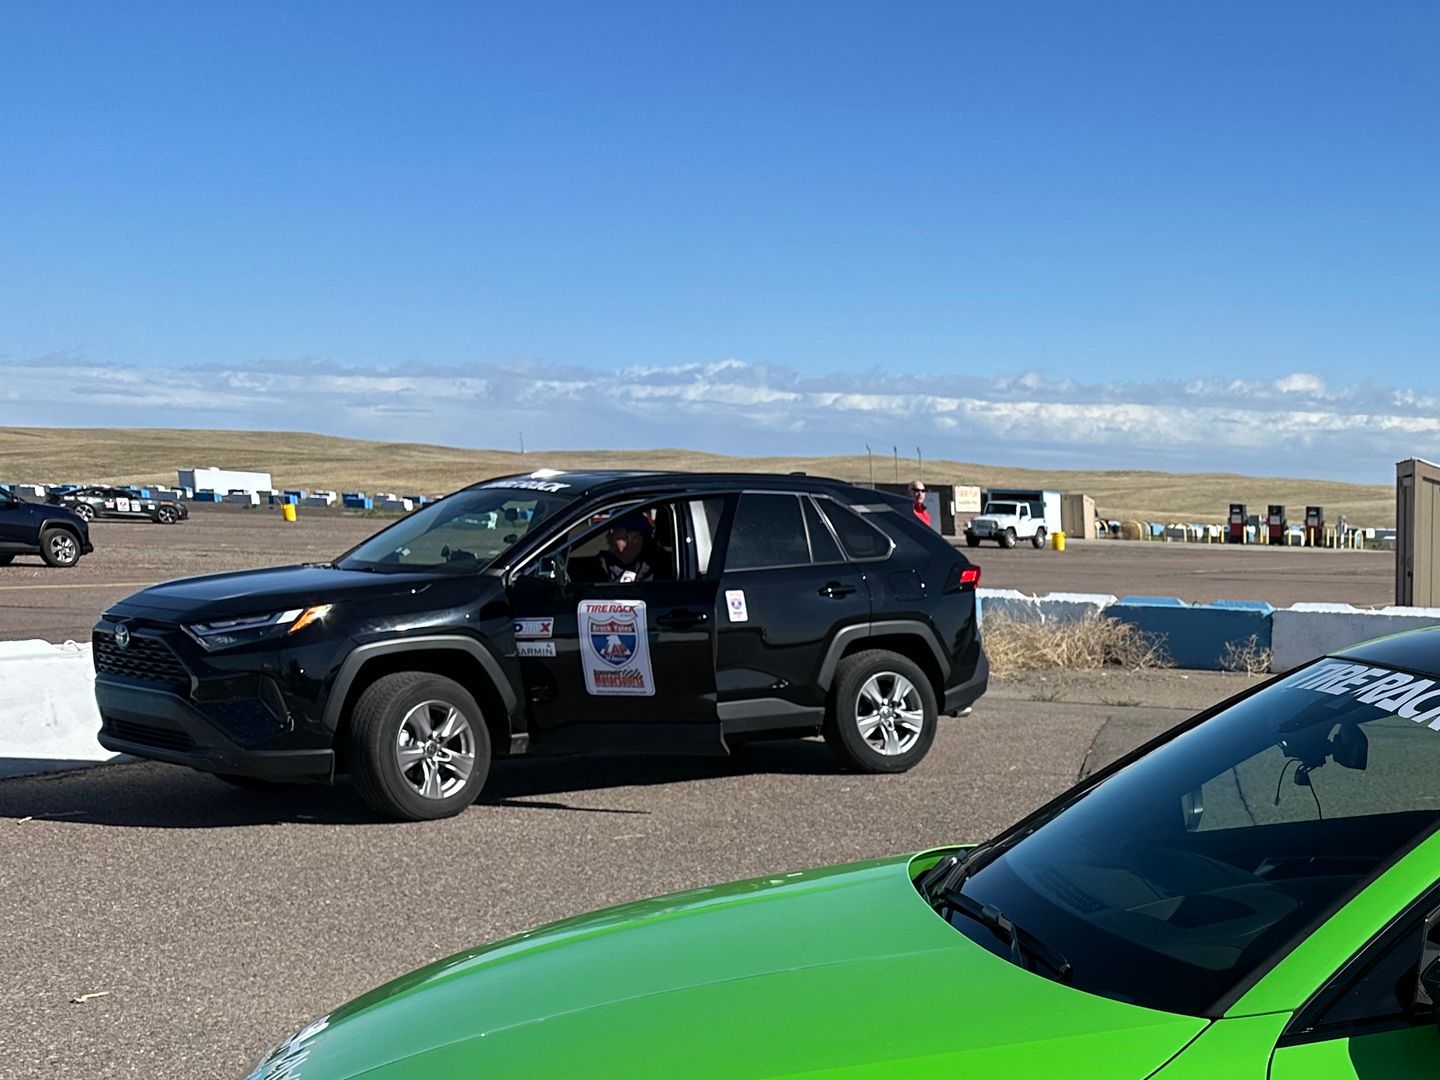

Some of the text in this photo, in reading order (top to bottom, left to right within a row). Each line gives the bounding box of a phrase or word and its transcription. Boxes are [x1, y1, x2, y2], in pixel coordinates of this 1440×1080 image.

[586, 605, 609, 614] TIRE
[608, 605, 638, 618] RACK
[592, 623, 612, 633] Brock
[516, 648, 553, 656] ARMIN
[1288, 663, 1385, 697] TIRE
